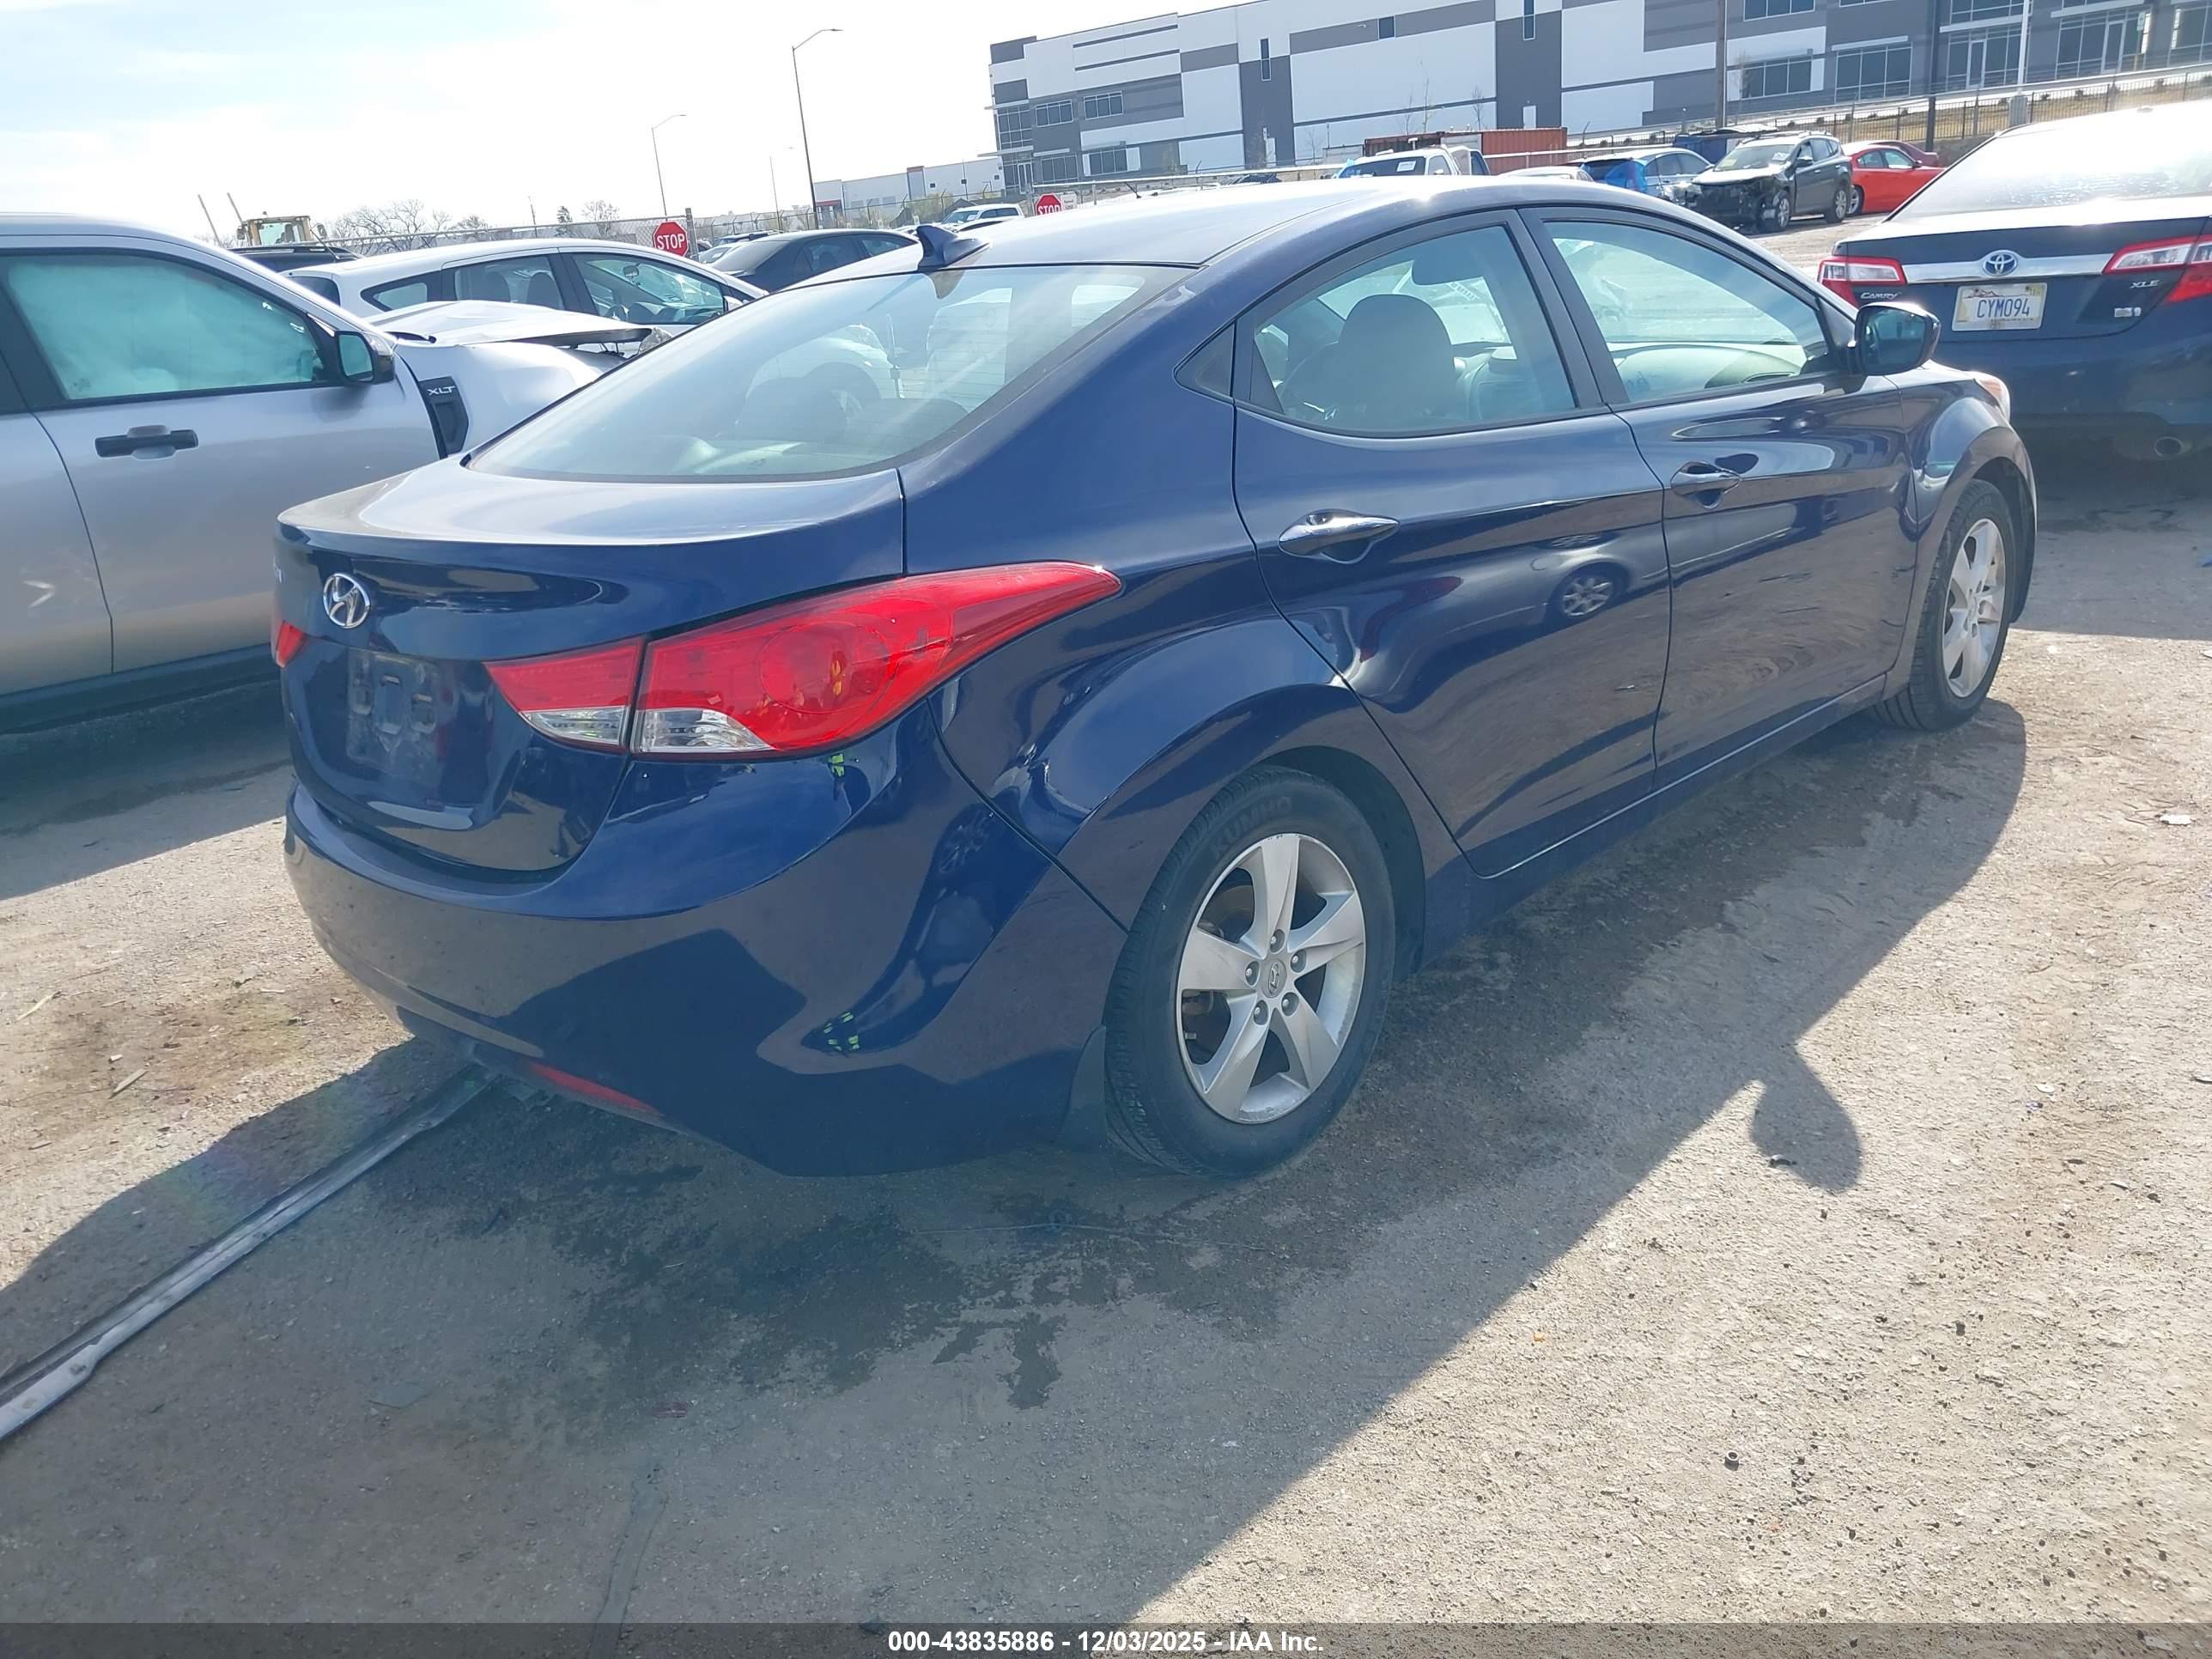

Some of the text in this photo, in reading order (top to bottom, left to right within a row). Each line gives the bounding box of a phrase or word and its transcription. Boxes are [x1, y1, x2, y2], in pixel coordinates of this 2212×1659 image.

[657, 233, 685, 250] STOP
[2130, 280, 2160, 289] XLE
[1977, 298, 2030, 318] CYM094
[427, 386, 455, 396] XLT
[1209, 796, 1292, 860] KUMHO
